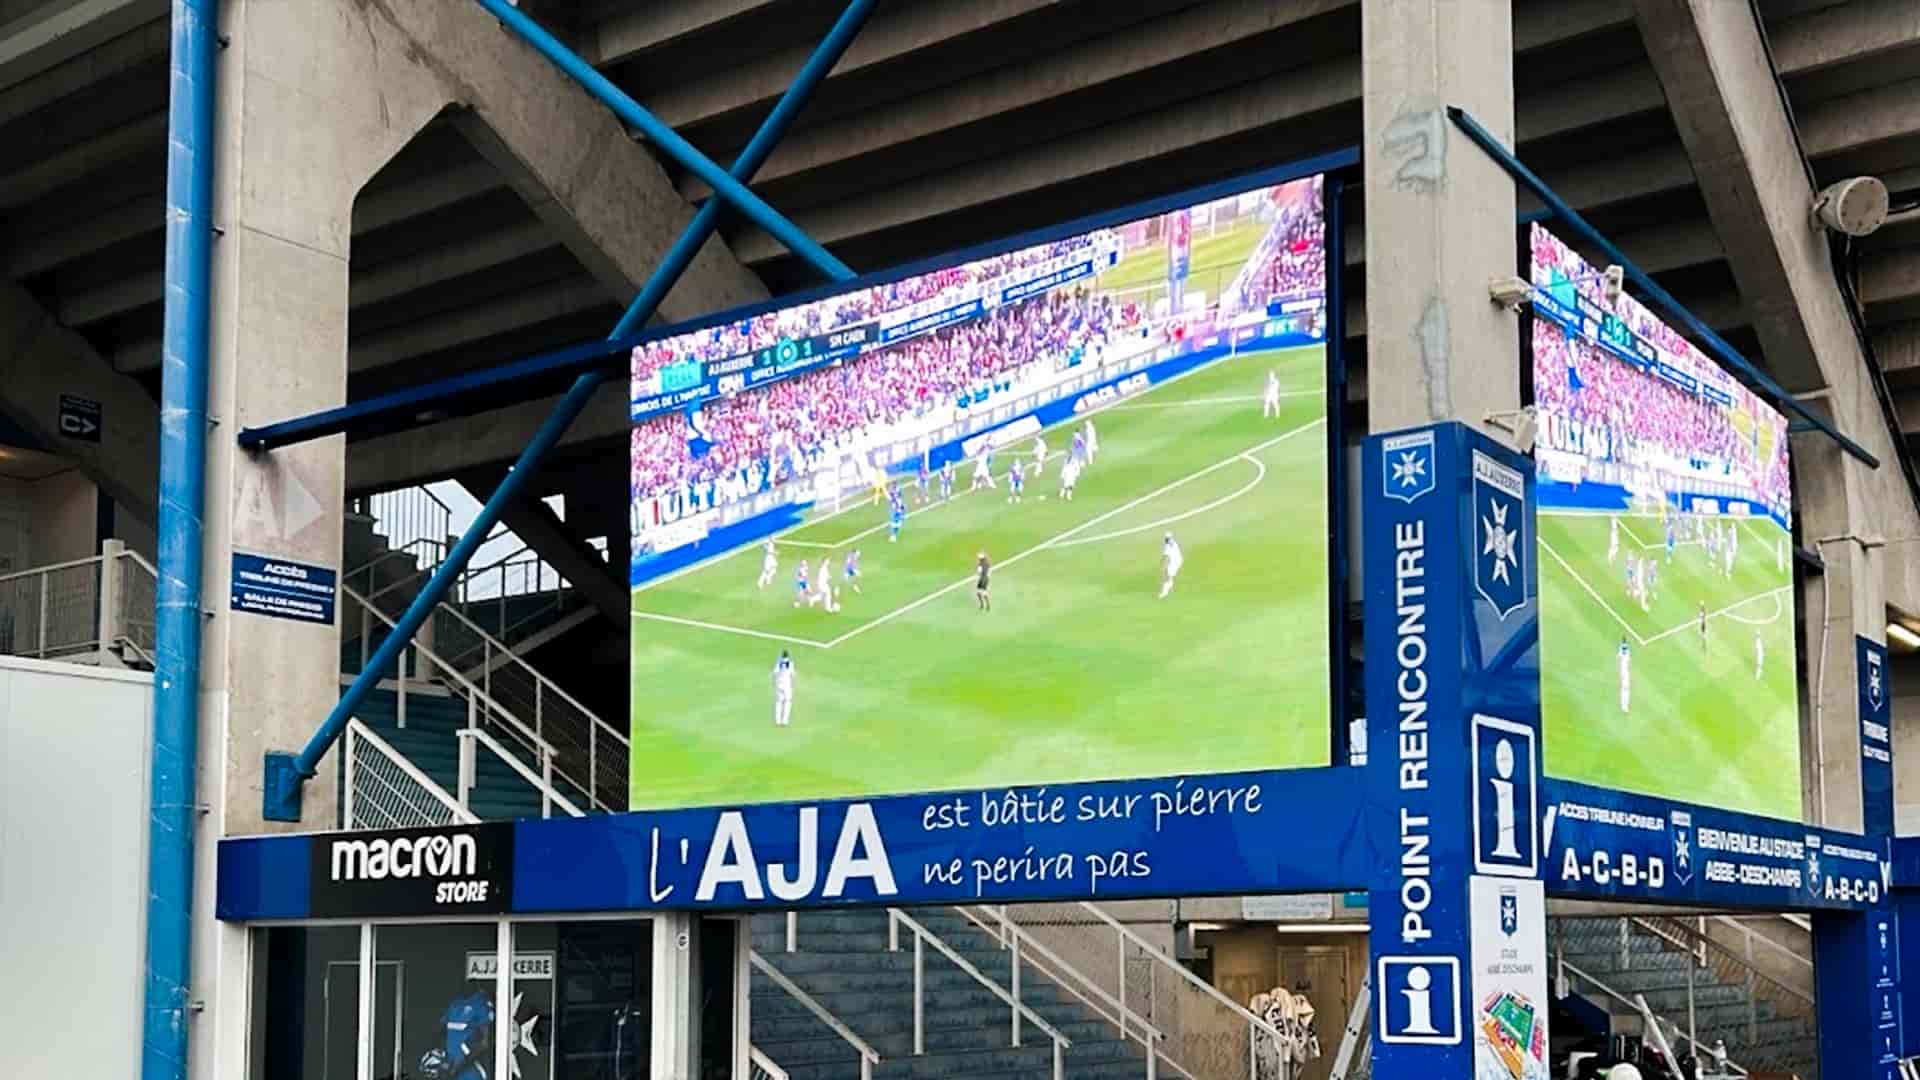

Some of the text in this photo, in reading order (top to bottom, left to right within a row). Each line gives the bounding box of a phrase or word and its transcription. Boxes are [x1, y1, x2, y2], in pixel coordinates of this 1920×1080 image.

[1396, 520, 1432, 941] POINT RENCONTRE
[923, 779, 1263, 832] est bâtie sur pierre
[331, 834, 477, 881] macron
[923, 846, 1151, 897] ne perira pas
[1561, 847, 1665, 889] A-C-B-D
[435, 880, 489, 904] STORE
